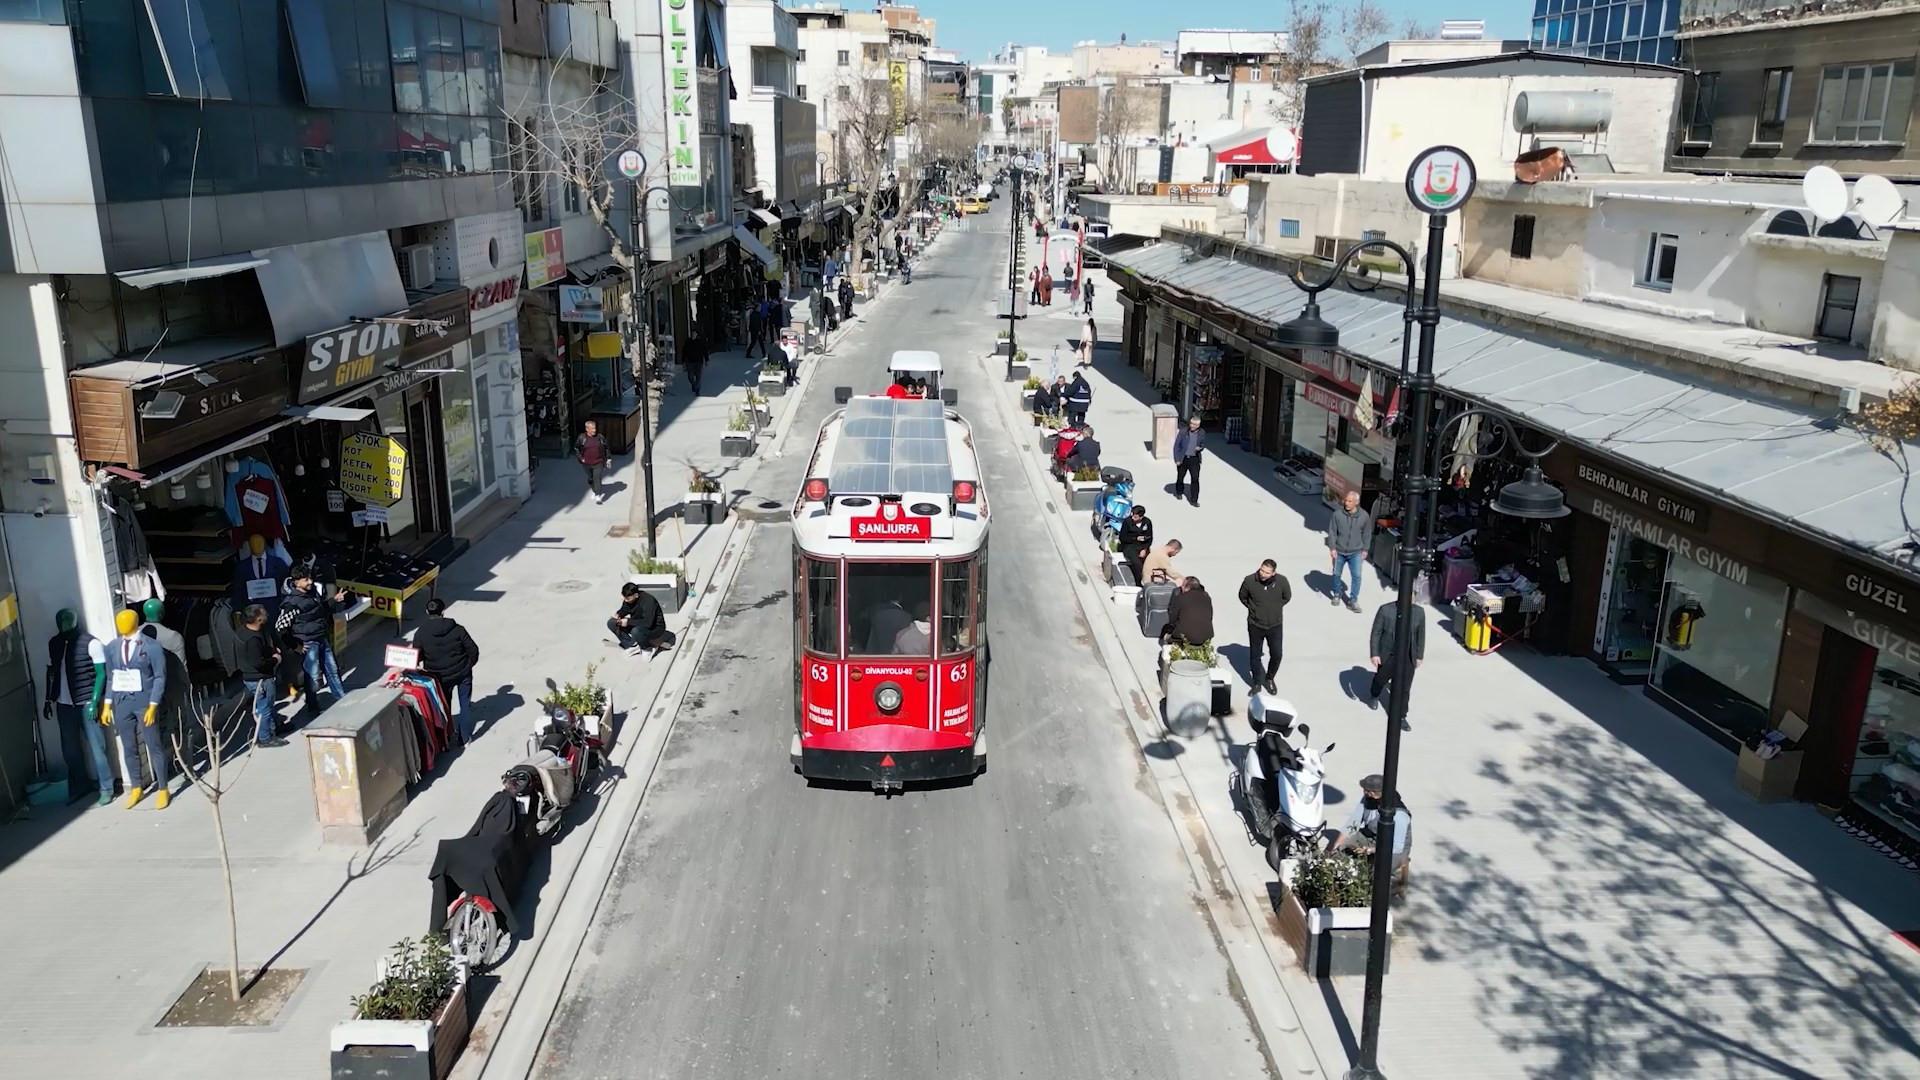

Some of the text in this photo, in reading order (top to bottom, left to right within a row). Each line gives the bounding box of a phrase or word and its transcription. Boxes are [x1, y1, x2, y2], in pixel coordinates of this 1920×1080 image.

[308, 322, 400, 372] STOK
[354, 434, 380, 448] STOK
[344, 446, 362, 455] KOT
[343, 457, 373, 470] KETEN
[384, 478, 400, 489] 200
[1578, 464, 1696, 525] BEHRAMLAR GİYİM
[858, 523, 919, 536] ŞANLIURFA
[1592, 499, 1691, 560] BEHRAMLAR
[1845, 574, 1908, 614] GÜZEL
[811, 664, 828, 683] 63
[950, 663, 967, 682] 63
